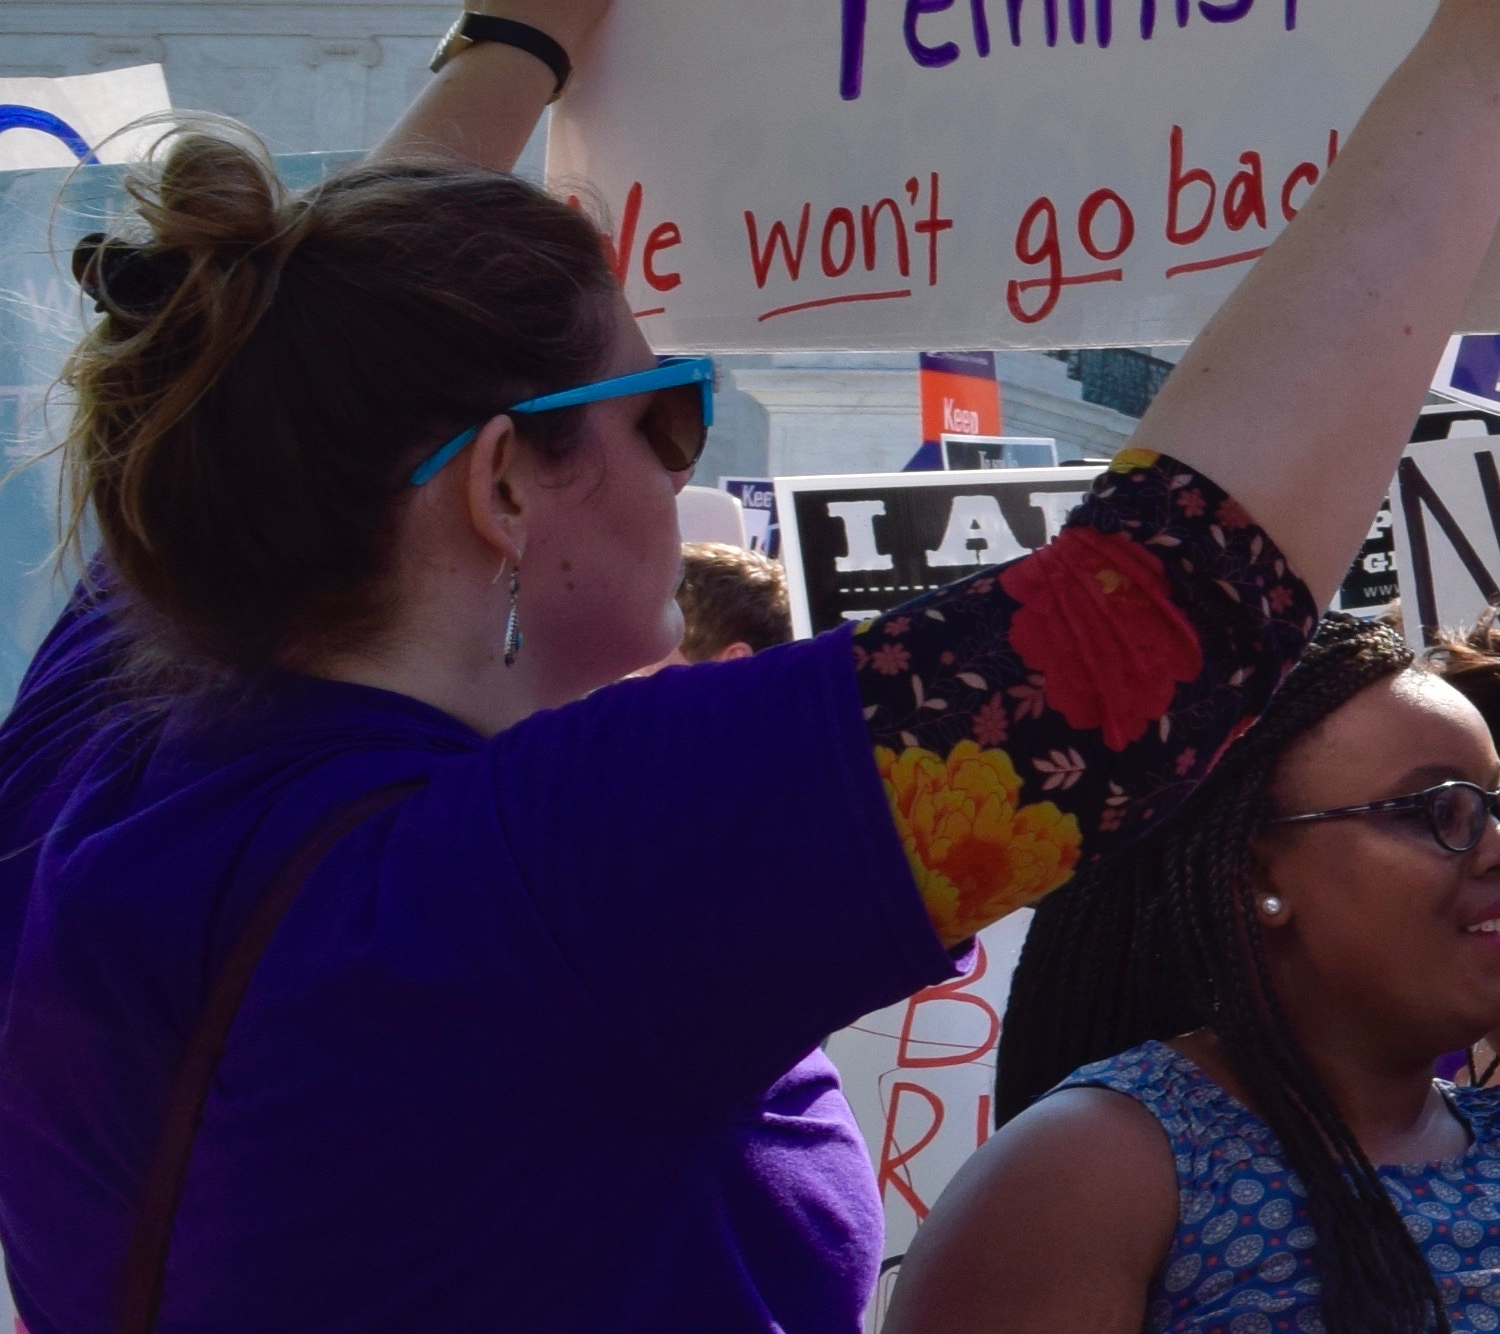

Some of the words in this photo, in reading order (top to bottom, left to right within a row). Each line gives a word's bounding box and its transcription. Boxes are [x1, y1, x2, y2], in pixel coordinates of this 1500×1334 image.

[744, 172, 953, 287] won't
[1006, 187, 1135, 324] go
[1165, 124, 1341, 242] bac
[741, 483, 775, 509] Kee
[826, 499, 894, 573] I
